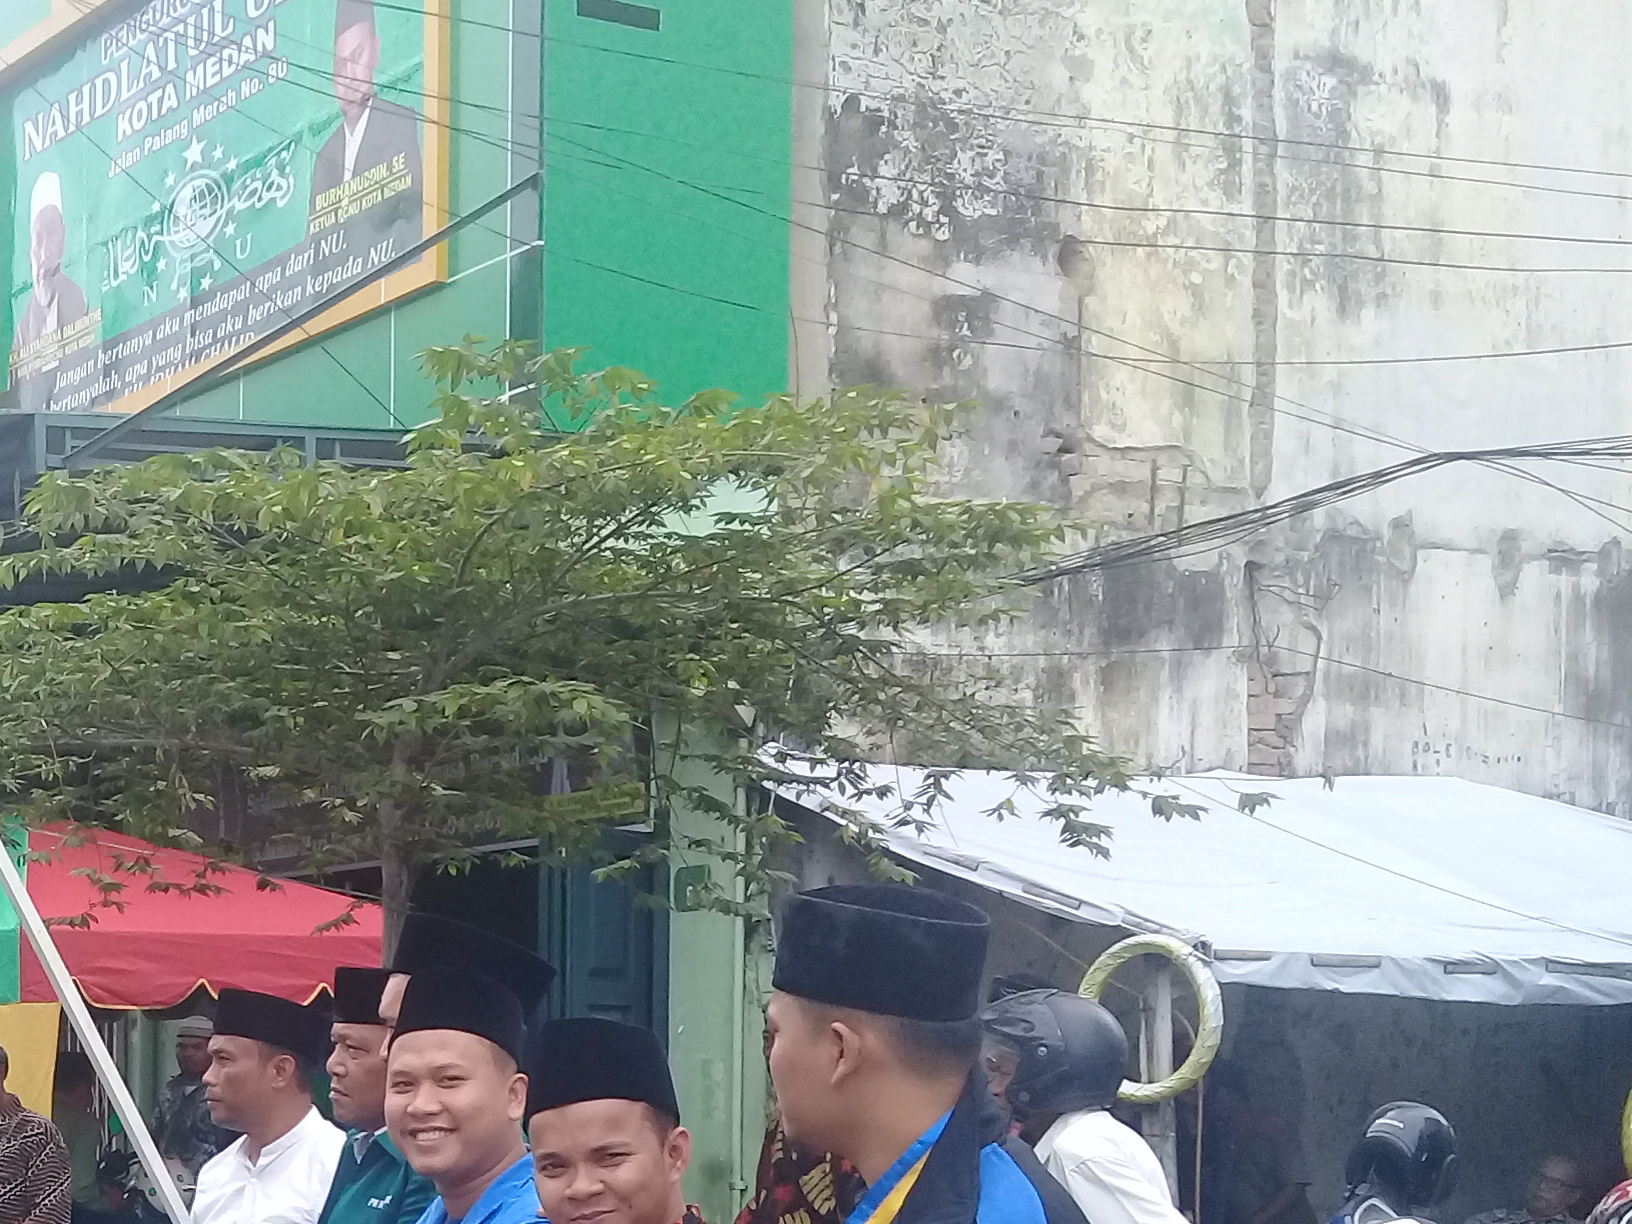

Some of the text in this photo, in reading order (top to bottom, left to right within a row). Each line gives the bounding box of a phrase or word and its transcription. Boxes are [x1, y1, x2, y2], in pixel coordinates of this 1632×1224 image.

[23, 0, 234, 161] NAHDLATUL
[108, 148, 141, 179] Jalan
[144, 118, 188, 155] Palang
[192, 89, 236, 129] Merah
[241, 76, 263, 100] No.
[117, 20, 275, 142] KOTA MEDAN
[309, 209, 335, 235] KETUA
[362, 189, 382, 210] KOTA
[392, 152, 406, 174] SE
[143, 281, 158, 307] N
[235, 233, 252, 259] U
[50, 370, 121, 411] bertanyalah,
[125, 359, 148, 383] apa
[151, 343, 182, 374] yang
[186, 328, 213, 354] bisa
[217, 313, 243, 337] aku
[248, 289, 302, 326] berikan
[306, 255, 362, 297] kepada
[368, 238, 396, 269] NU.
[54, 358, 94, 394] Jangan
[97, 329, 152, 369] bertanya
[156, 317, 180, 341] aku
[183, 278, 250, 326] mendapat
[255, 267, 281, 293] apa
[285, 248, 314, 277] dari
[319, 230, 347, 260] NU.
